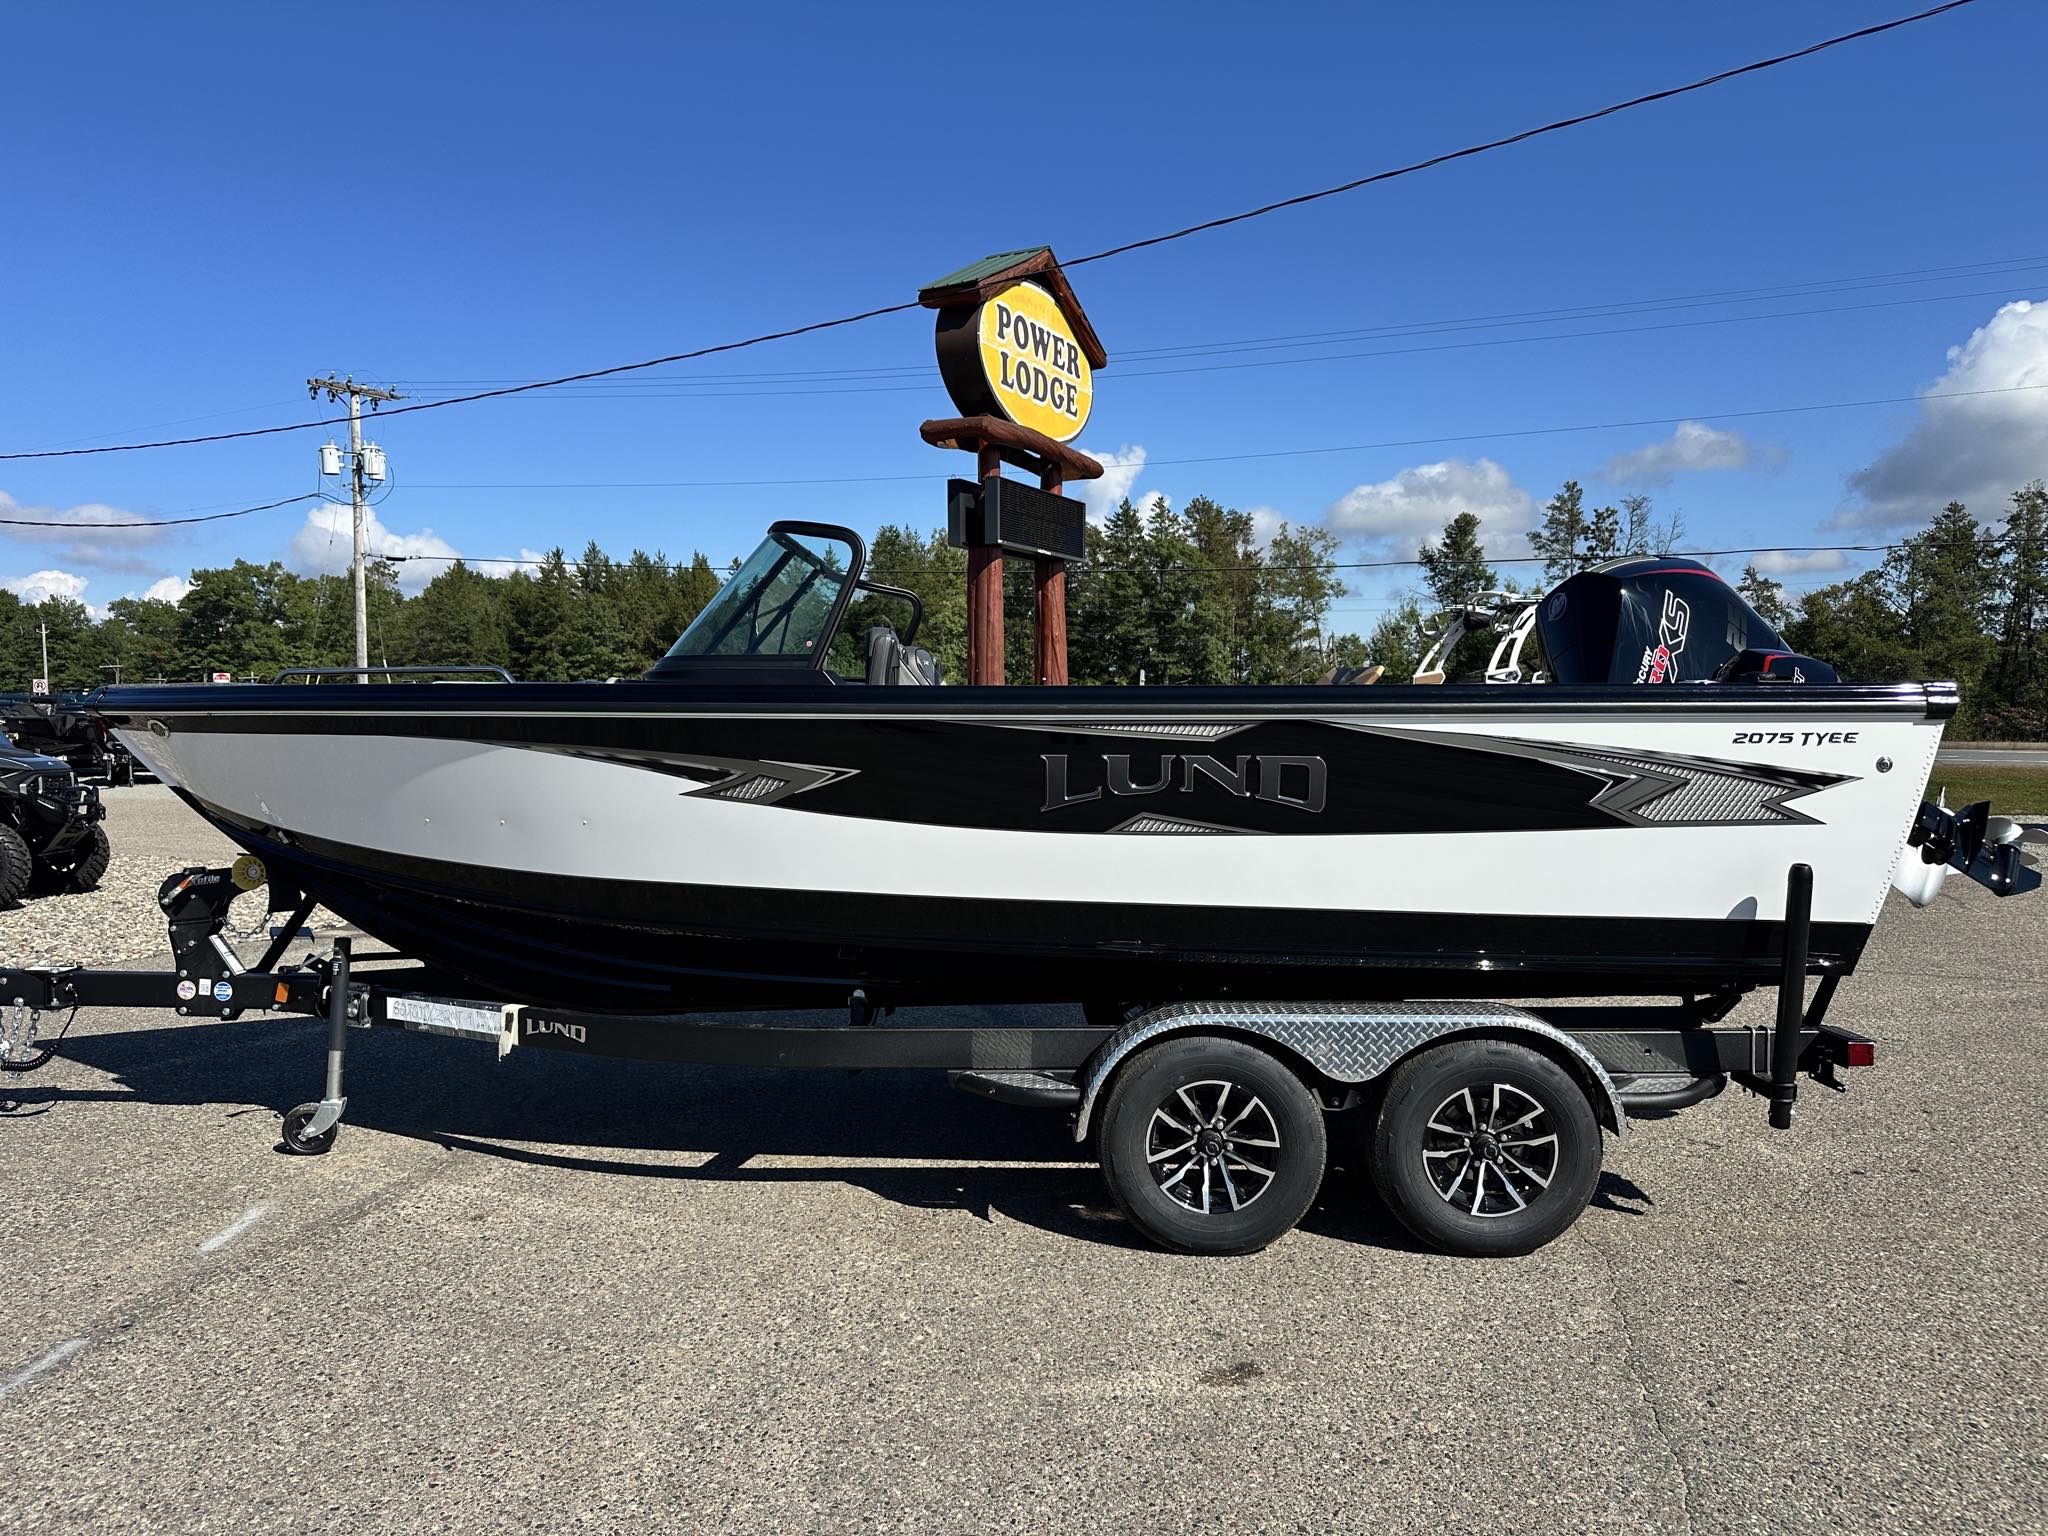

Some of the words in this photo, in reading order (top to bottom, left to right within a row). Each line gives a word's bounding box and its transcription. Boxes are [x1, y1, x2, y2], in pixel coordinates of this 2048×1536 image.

[997, 303, 1081, 379] POWER
[1000, 351, 1078, 417] LODGE
[1732, 732, 1794, 744] 2075
[1800, 732, 1860, 747] TYEE
[1039, 754, 1328, 814] LUND
[525, 1018, 587, 1043] LUND
